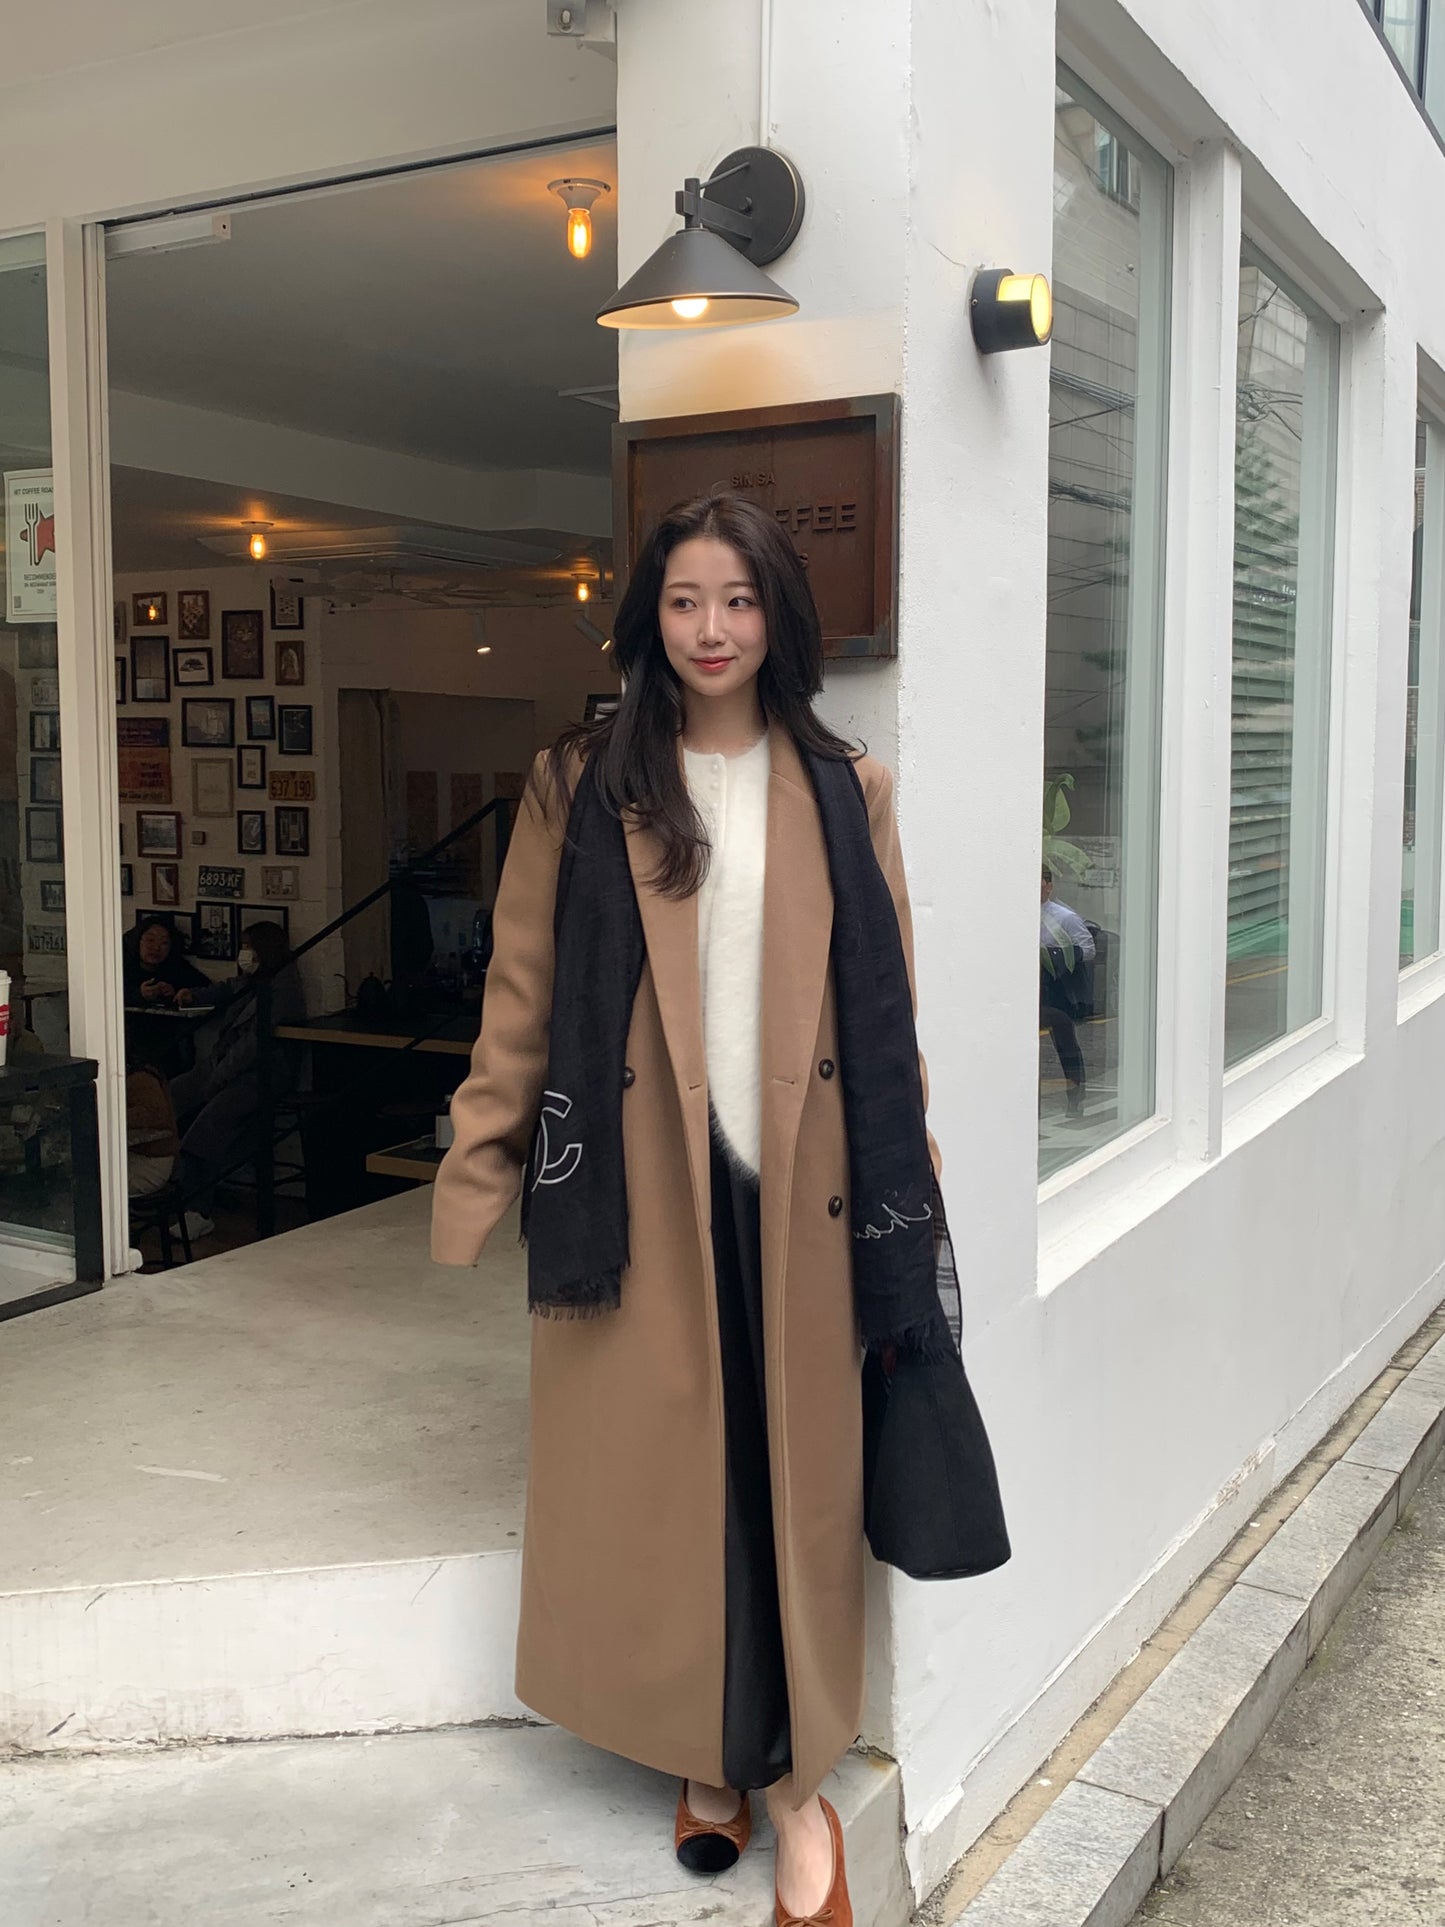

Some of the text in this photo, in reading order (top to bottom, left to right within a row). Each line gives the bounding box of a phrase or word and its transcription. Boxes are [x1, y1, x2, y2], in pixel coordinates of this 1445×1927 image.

[730, 471, 776, 488] SIN SA
[22, 487, 40, 495] COFFEE
[773, 503, 857, 533] FFEE
